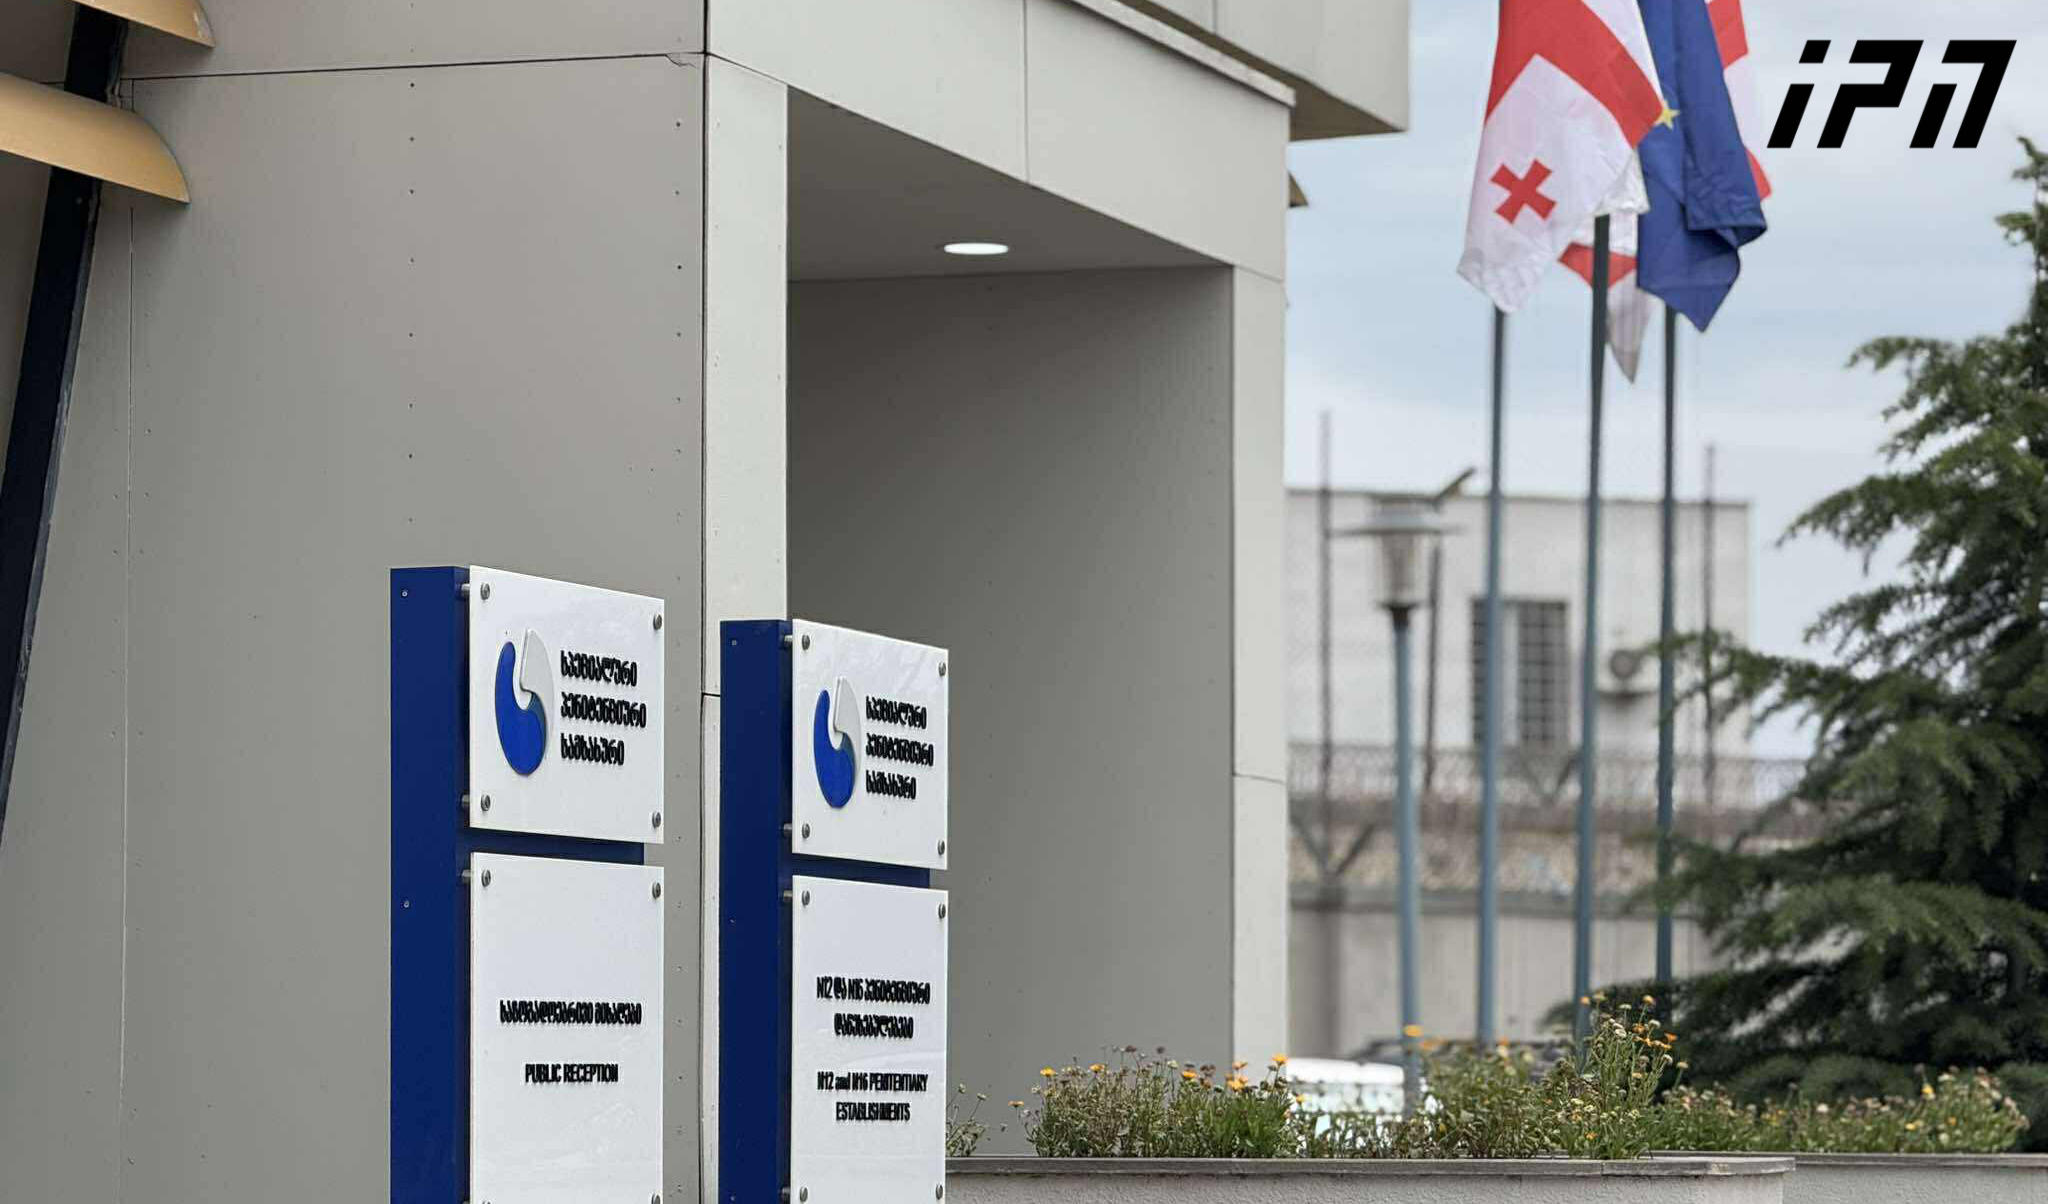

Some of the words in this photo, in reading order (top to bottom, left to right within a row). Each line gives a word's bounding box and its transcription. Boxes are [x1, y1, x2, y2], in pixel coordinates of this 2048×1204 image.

[561, 650, 637, 687] სპეციალური
[561, 692, 646, 728] პენიტენციური
[866, 696, 927, 729] სპეციალური
[561, 733, 624, 766] სამსახური
[866, 770, 916, 799] სამსახური
[525, 1064, 561, 1083] PUBLIC
[563, 1064, 618, 1082] RECEPTION
[835, 1072, 851, 1090] and
[869, 1073, 928, 1092] PENITENTIARY
[836, 1102, 910, 1121] ESTABLISHMENTS
